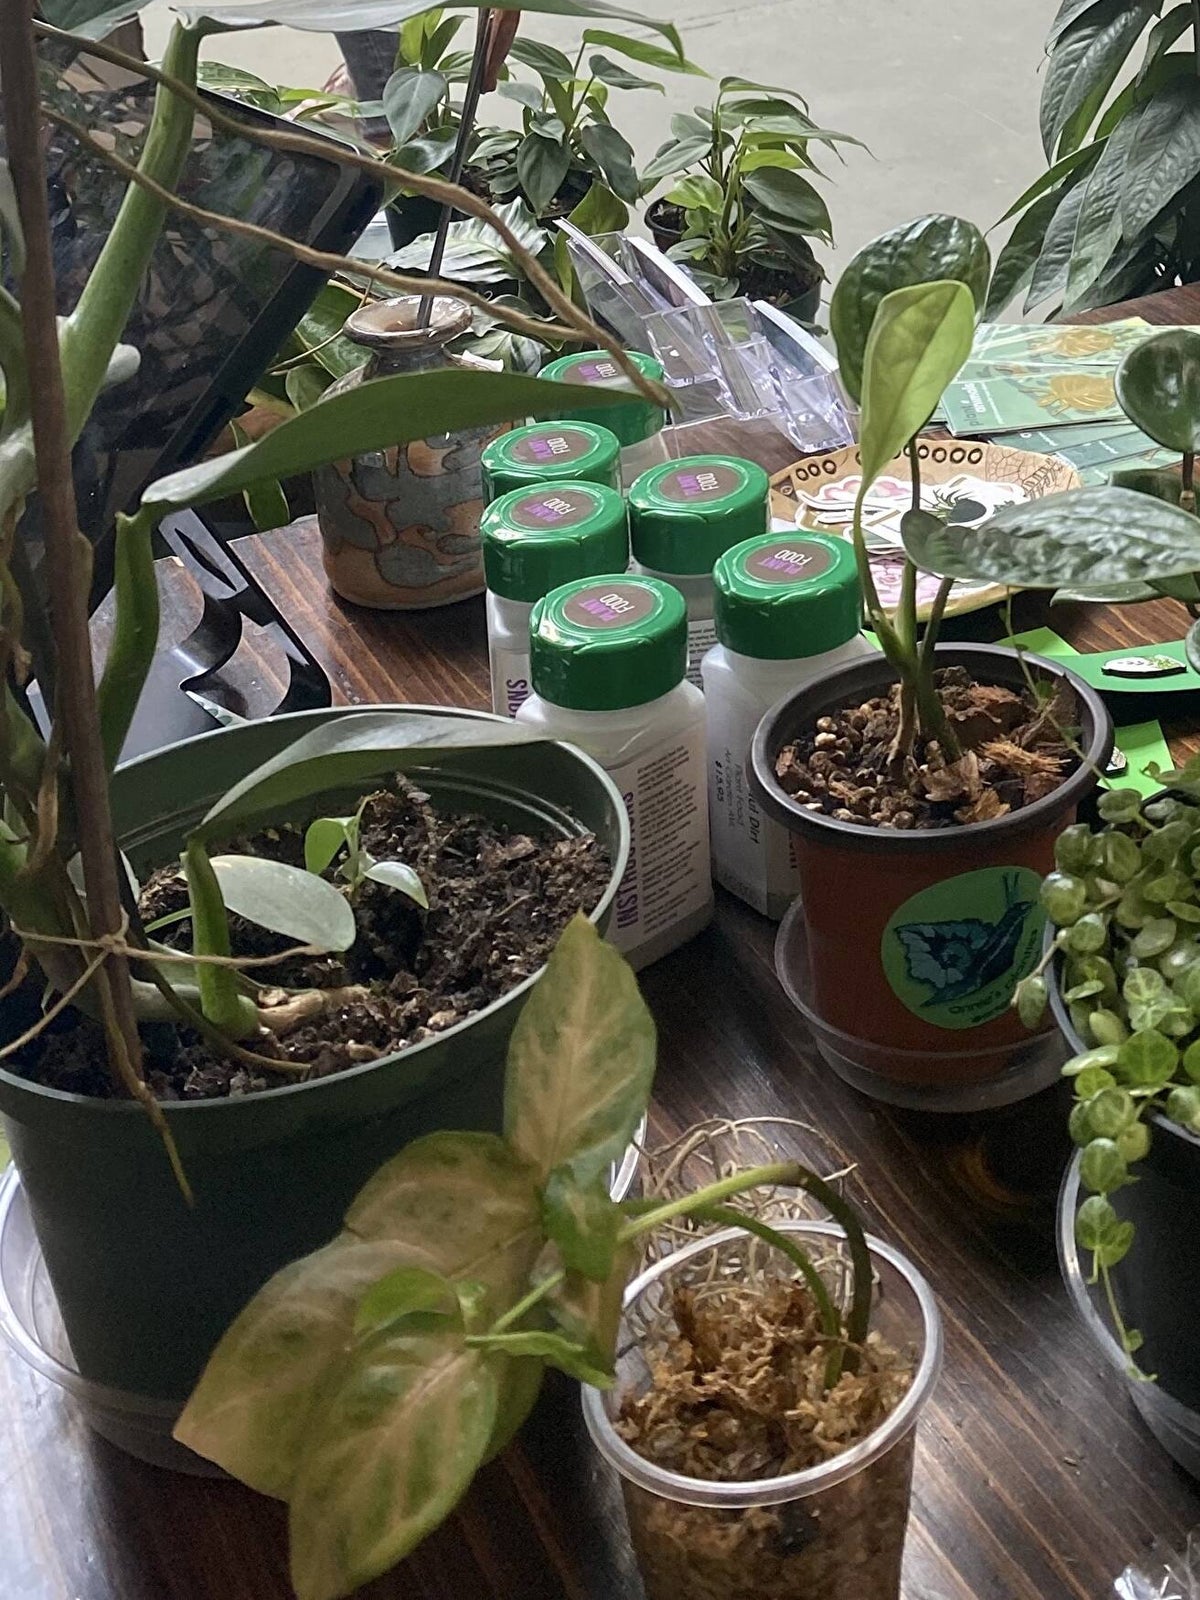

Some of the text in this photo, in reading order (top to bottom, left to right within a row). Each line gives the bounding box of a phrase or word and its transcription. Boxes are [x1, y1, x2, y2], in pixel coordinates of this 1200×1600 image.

[595, 363, 617, 378] FOOD
[528, 438, 554, 460] PLANT
[547, 437, 571, 455] FOOD
[676, 474, 701, 497] PLANT
[696, 472, 720, 492] FOOD
[523, 503, 561, 523] PLANT
[542, 497, 576, 516] FOOD
[757, 556, 805, 576] PLANT
[774, 549, 813, 567] FOOD
[578, 598, 618, 622] PLANT
[599, 593, 636, 613] FOOD
[748, 817, 760, 844] Dirt
